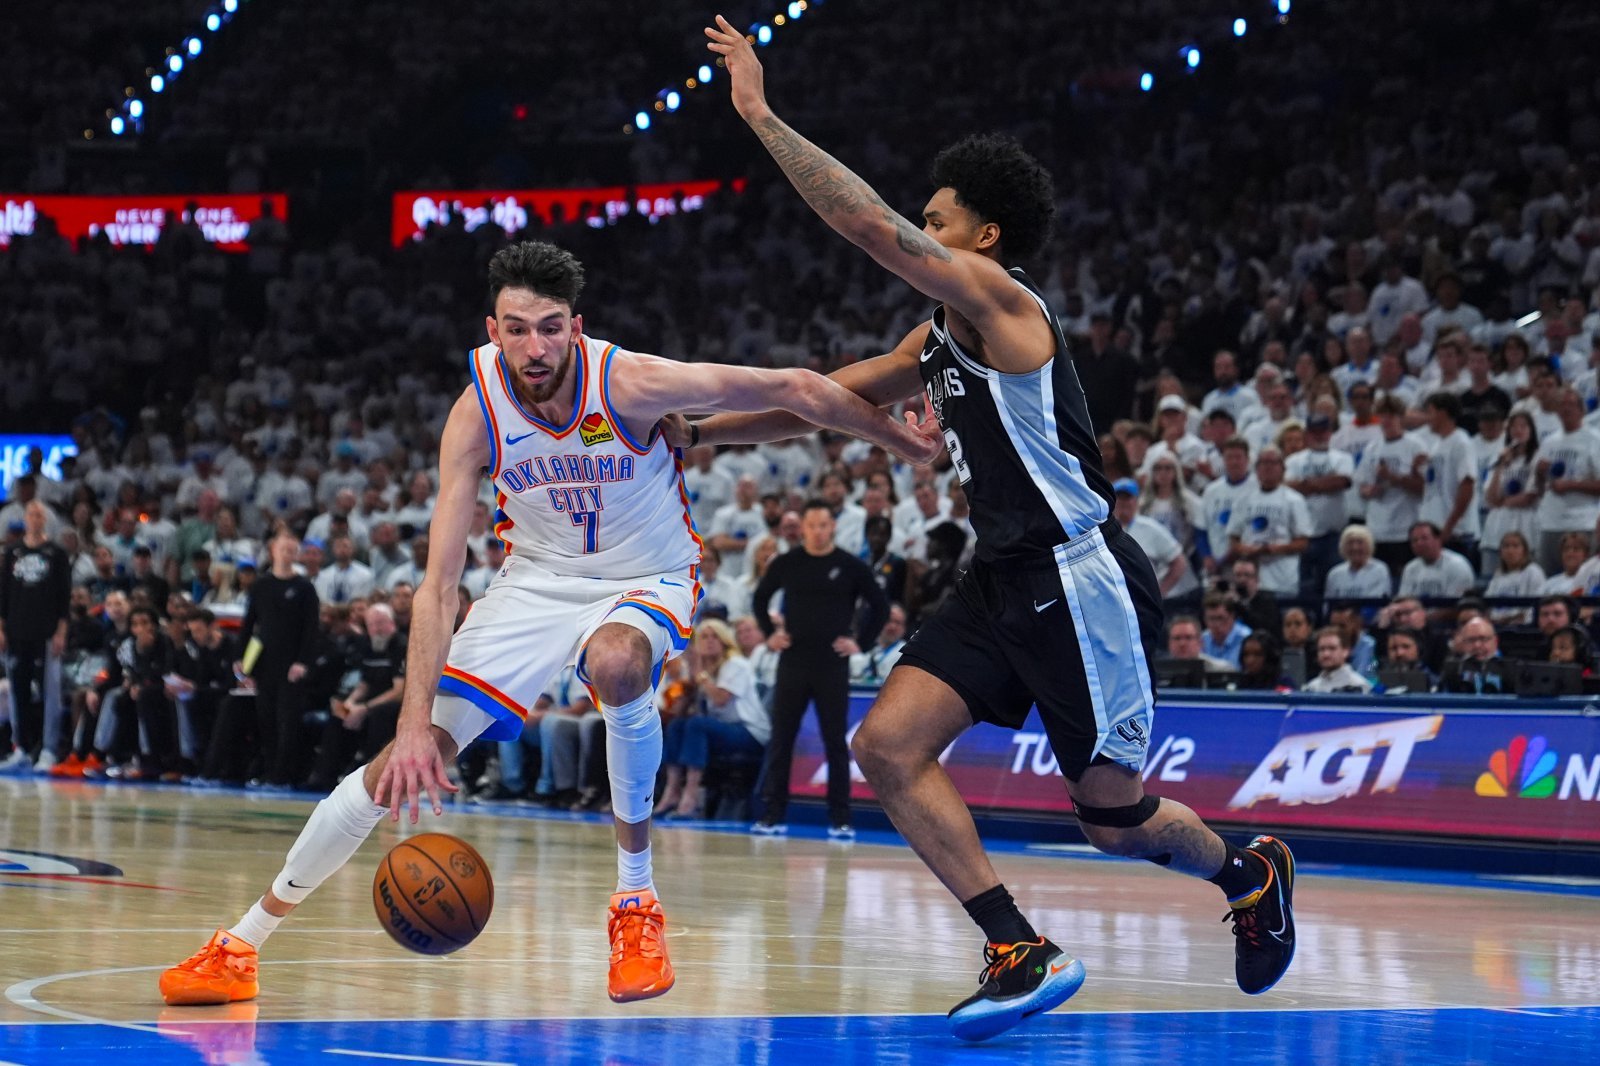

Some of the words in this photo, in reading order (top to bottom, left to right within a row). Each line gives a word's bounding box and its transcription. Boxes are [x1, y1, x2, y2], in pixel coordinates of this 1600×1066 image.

[501, 455, 634, 493] OKLAHOMA
[547, 486, 604, 513] CITY
[570, 511, 599, 554] 7
[1012, 733, 1063, 776] TU
[1227, 714, 1444, 811] AGT
[1558, 753, 1600, 801] N
